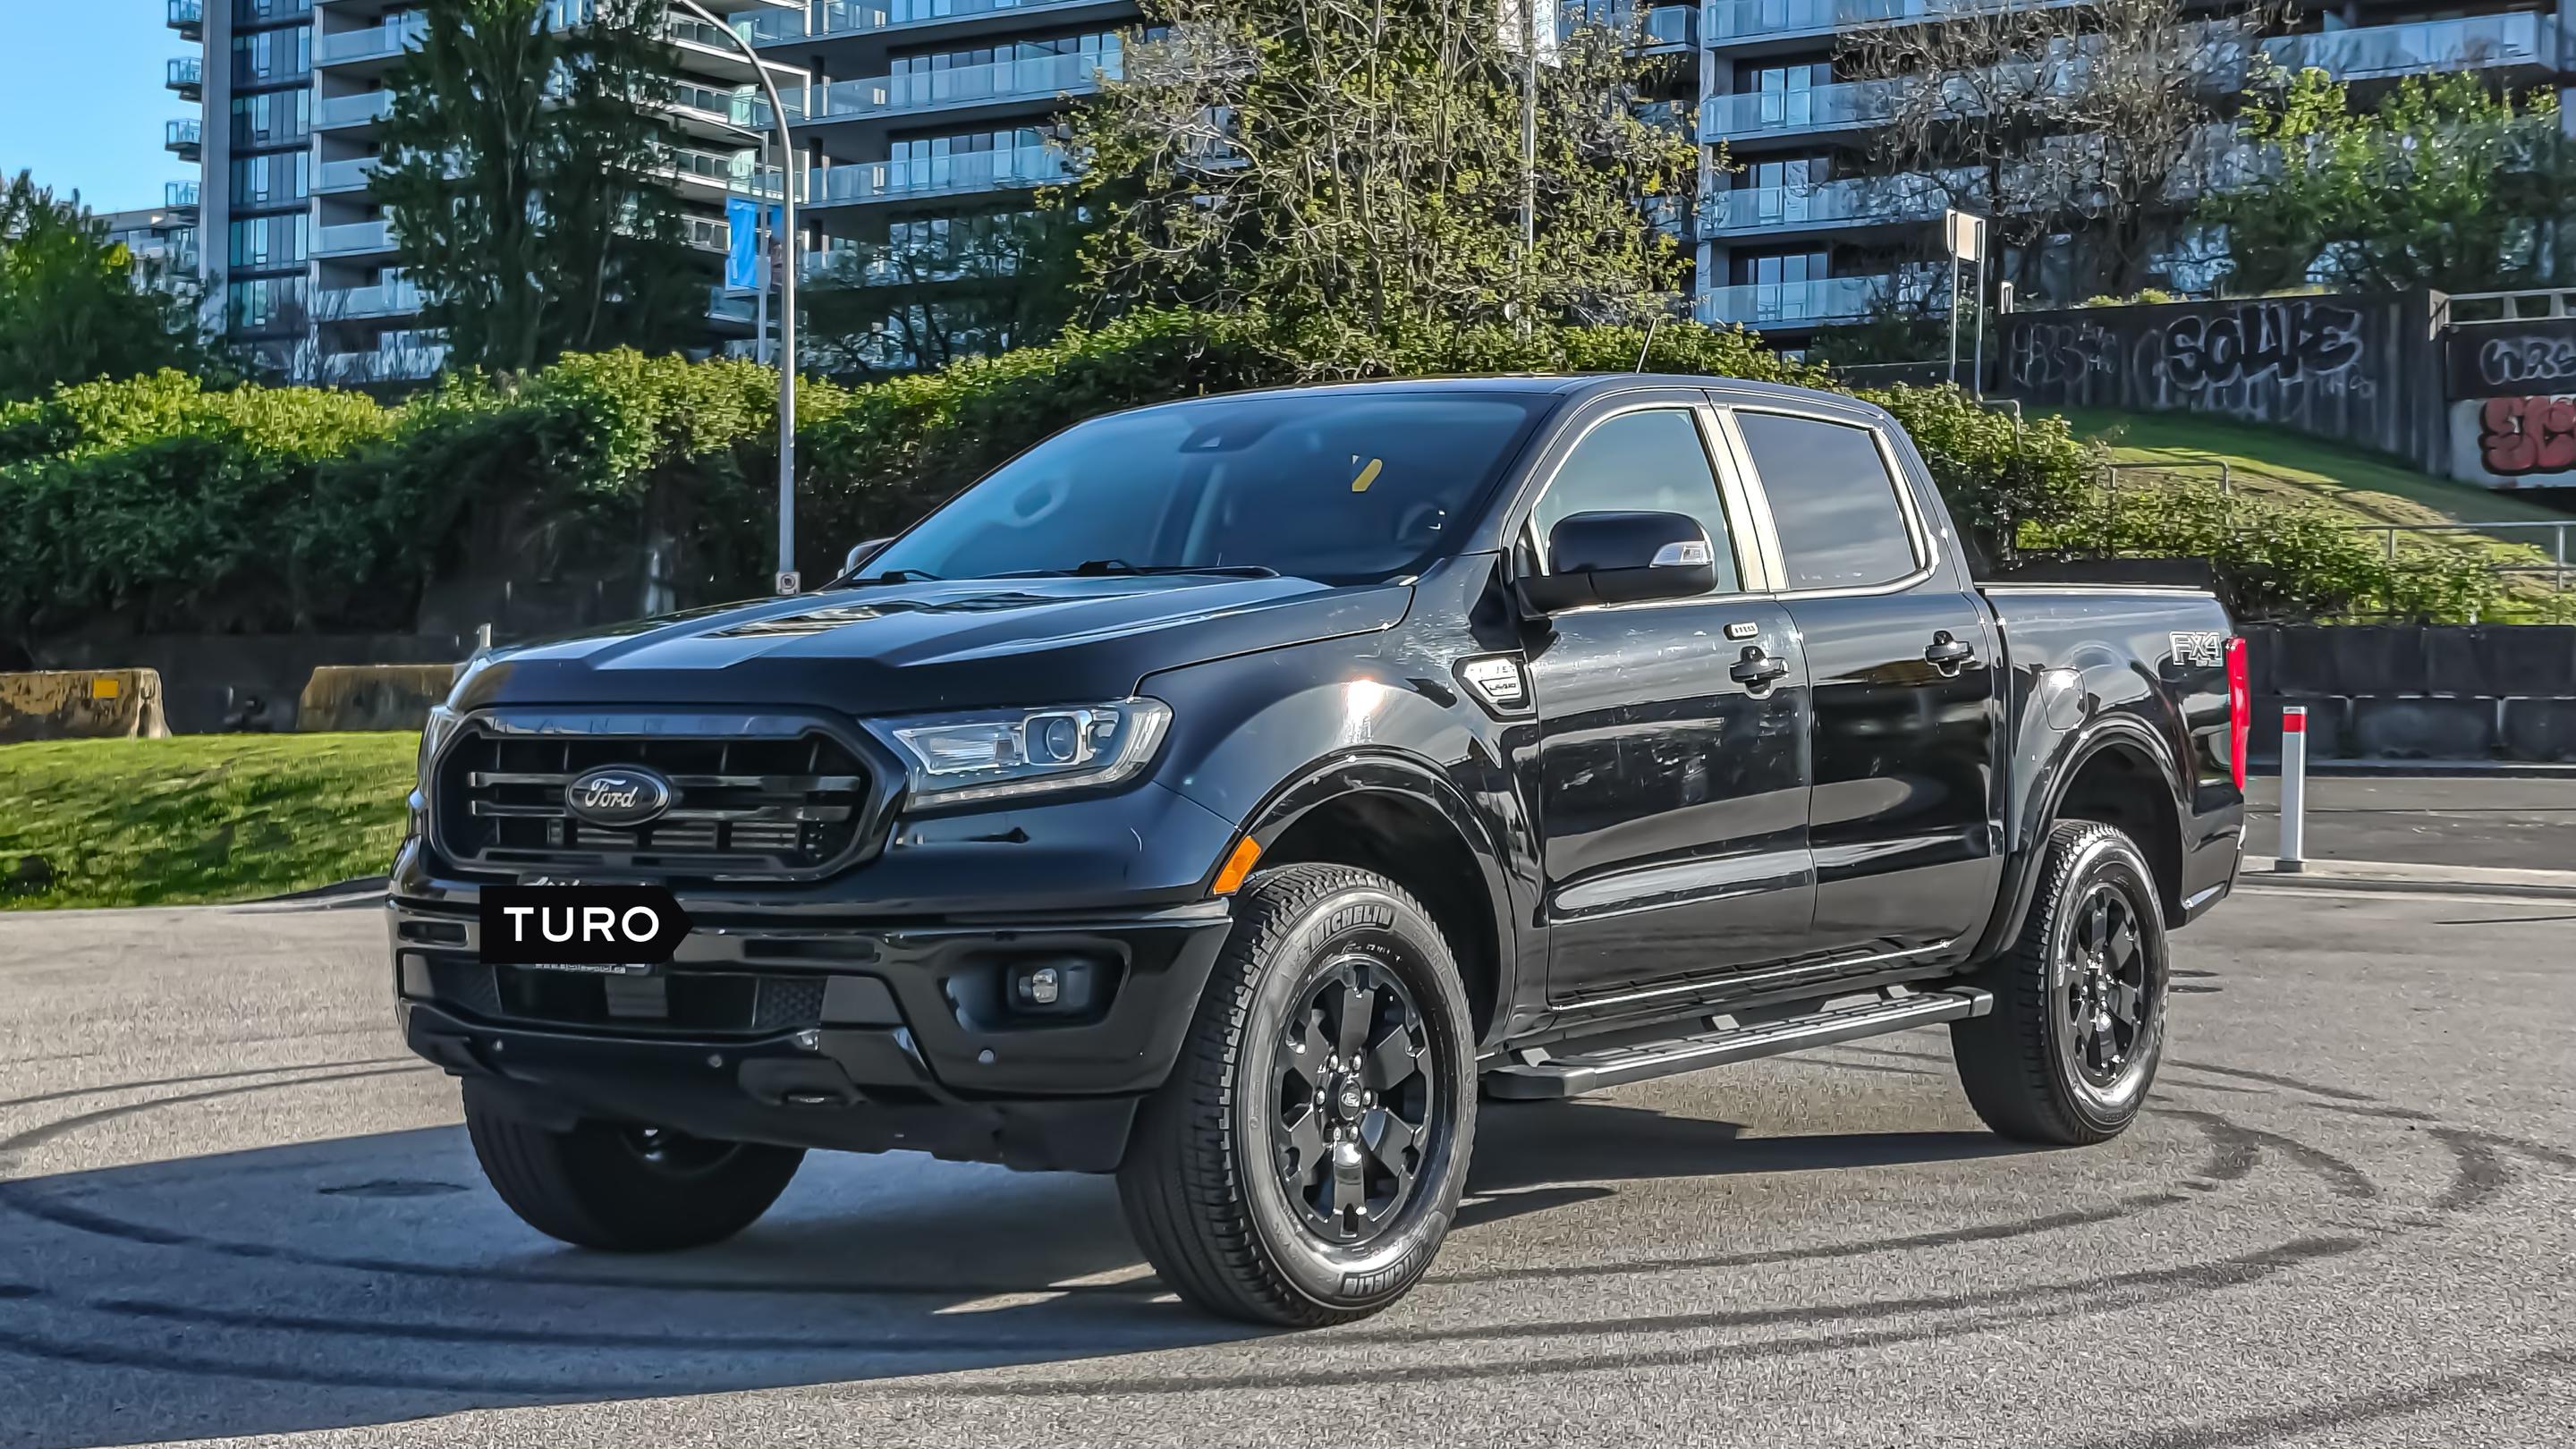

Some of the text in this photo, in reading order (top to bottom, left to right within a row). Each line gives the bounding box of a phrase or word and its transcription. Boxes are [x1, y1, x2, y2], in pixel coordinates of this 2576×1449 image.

[2169, 631, 2223, 665] FX4
[585, 777, 639, 808] Ford
[1310, 904, 1393, 952] MICHELIN
